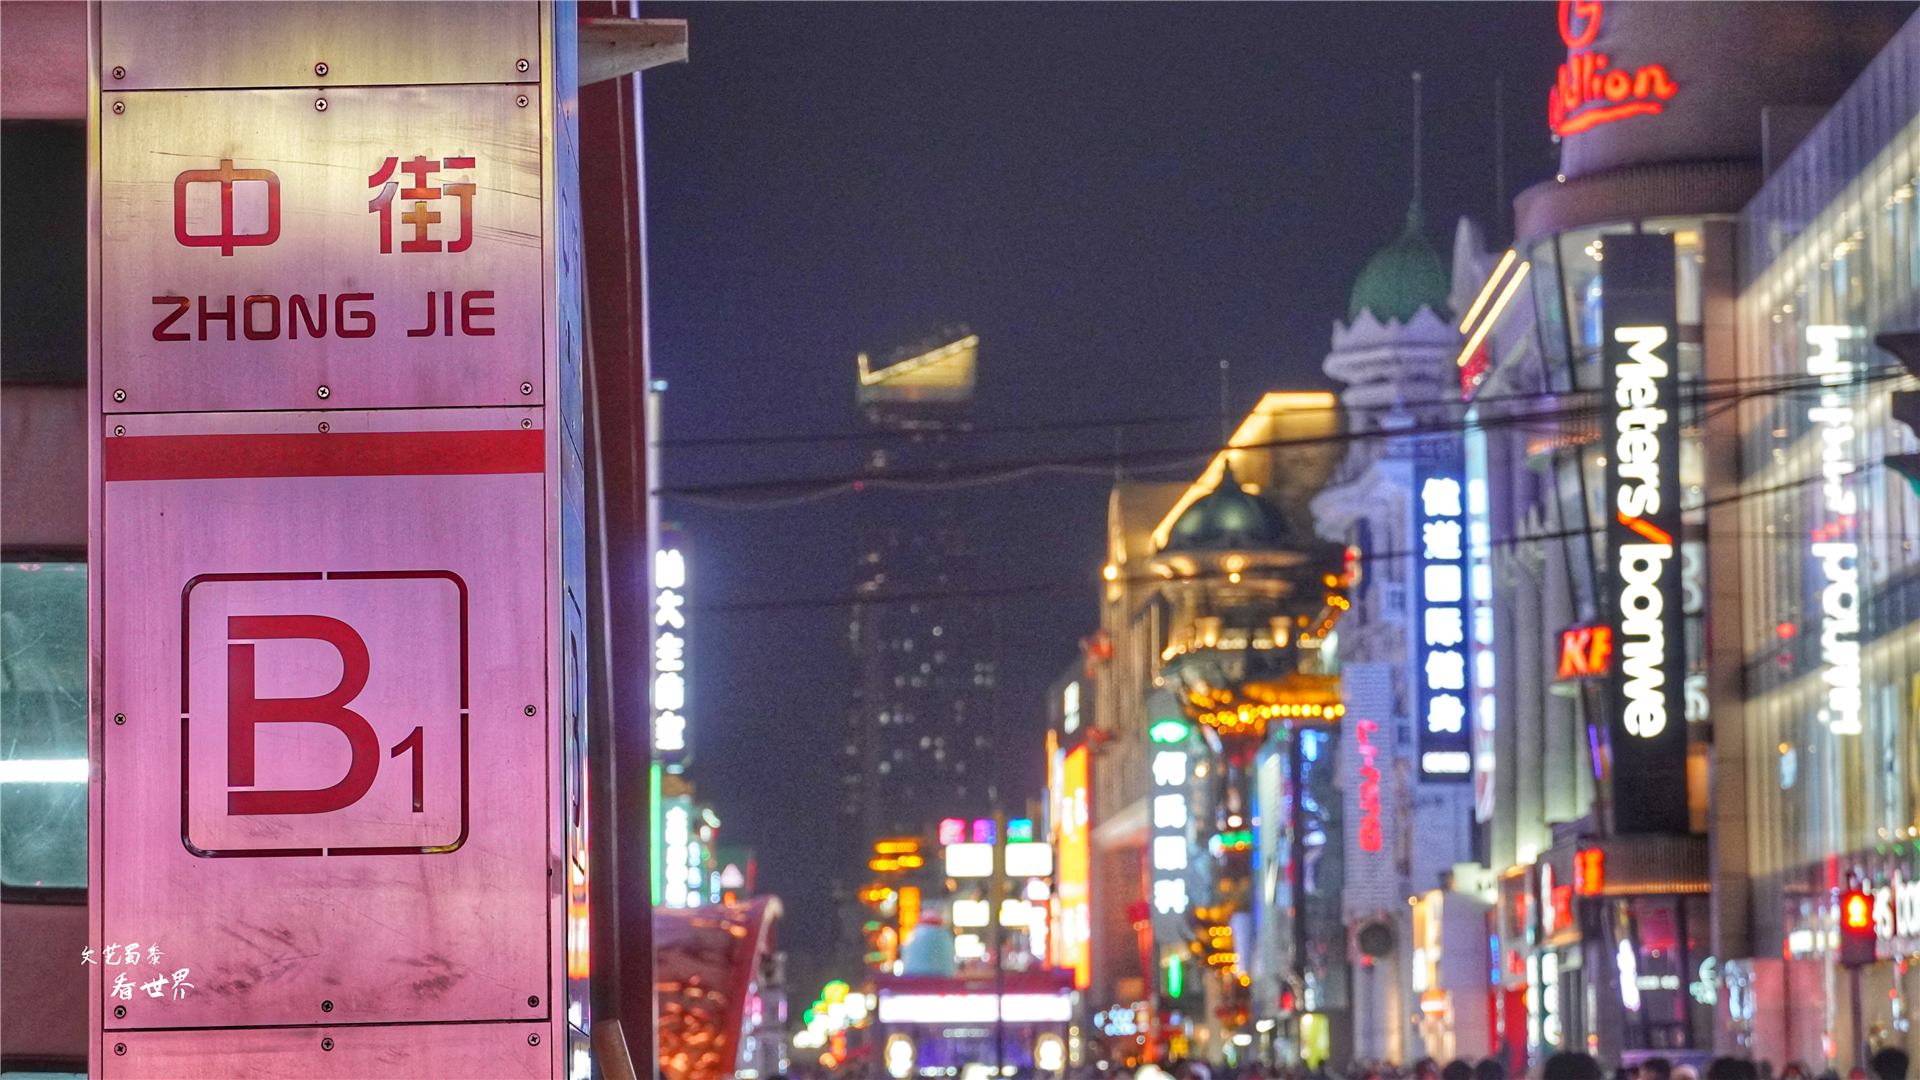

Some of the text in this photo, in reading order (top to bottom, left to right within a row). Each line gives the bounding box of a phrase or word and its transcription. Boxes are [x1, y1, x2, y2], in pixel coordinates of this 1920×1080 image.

[173, 156, 477, 258] 中街
[151, 289, 496, 342] ZHONG JIE
[1614, 325, 1673, 738] Meters/bonwe
